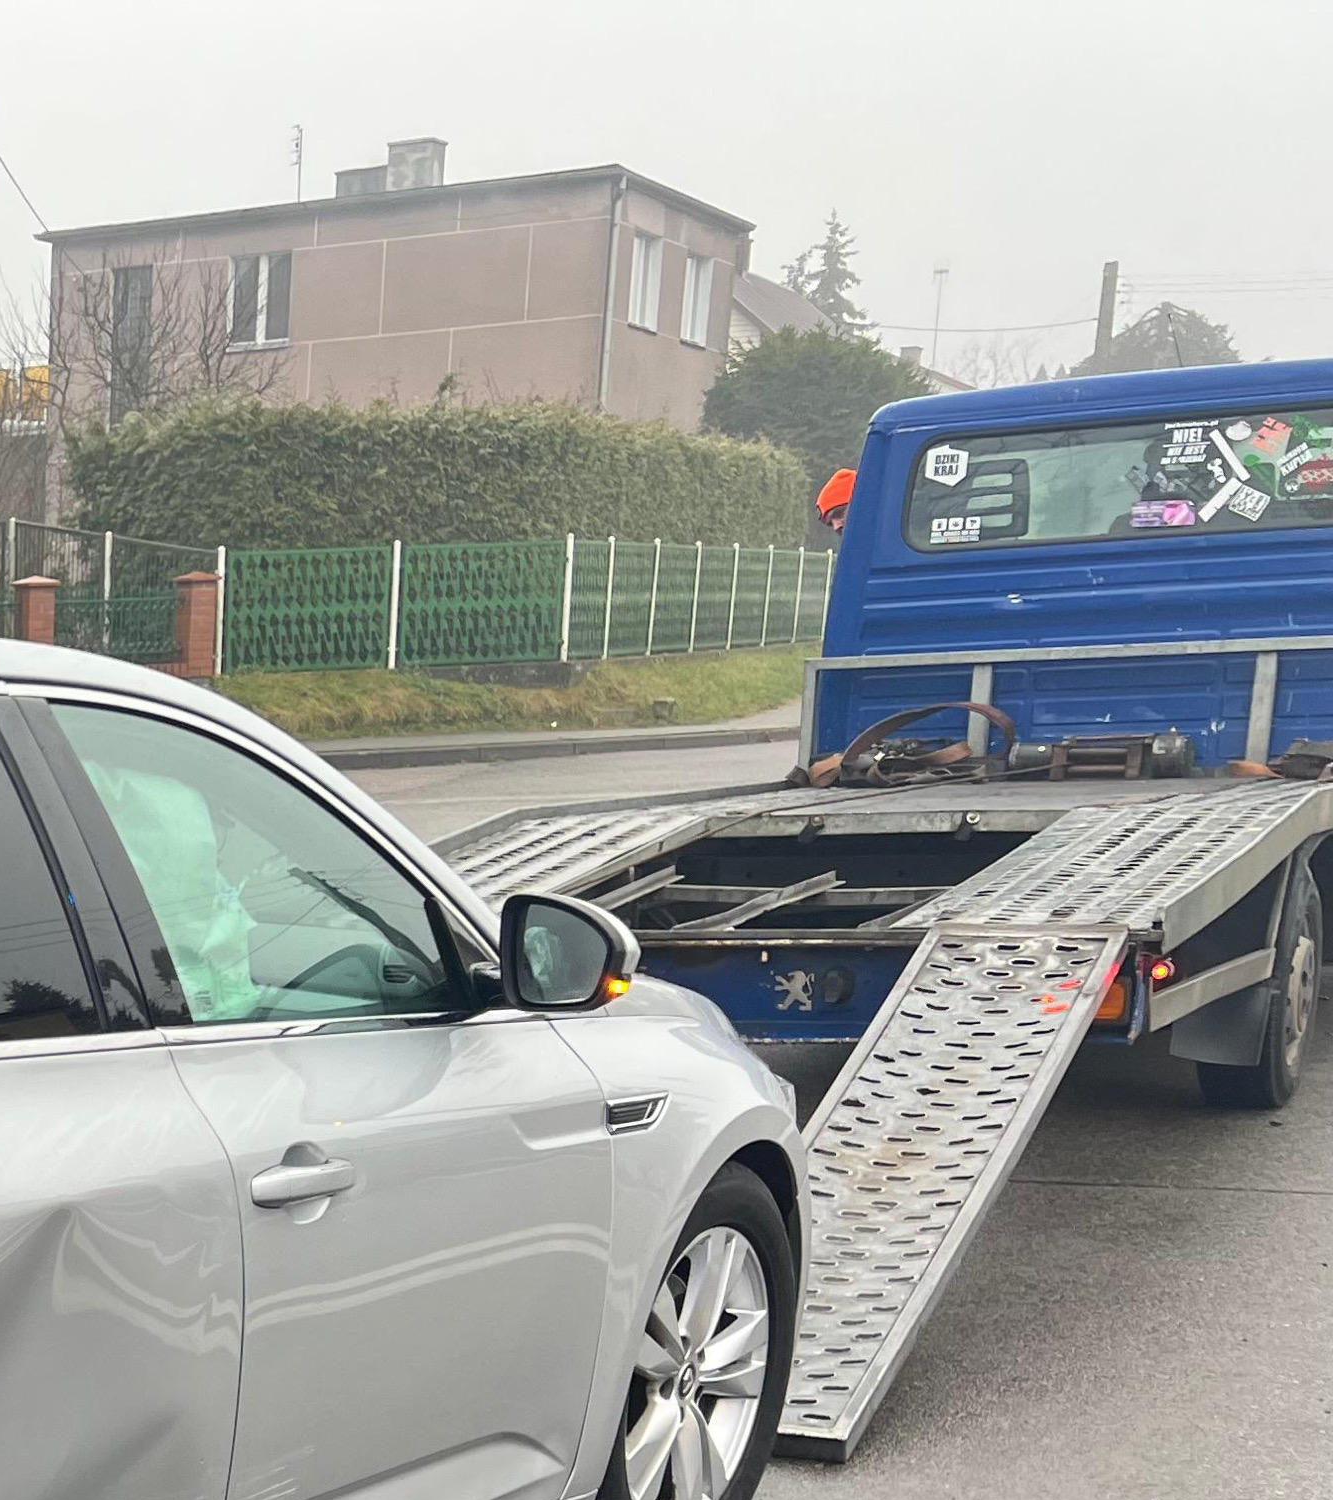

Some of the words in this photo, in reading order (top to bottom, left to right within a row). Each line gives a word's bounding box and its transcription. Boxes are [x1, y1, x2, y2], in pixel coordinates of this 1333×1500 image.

[1172, 427, 1203, 444] NIE!
[935, 453, 960, 464] DZIKI
[933, 465, 958, 476] KRAJ
